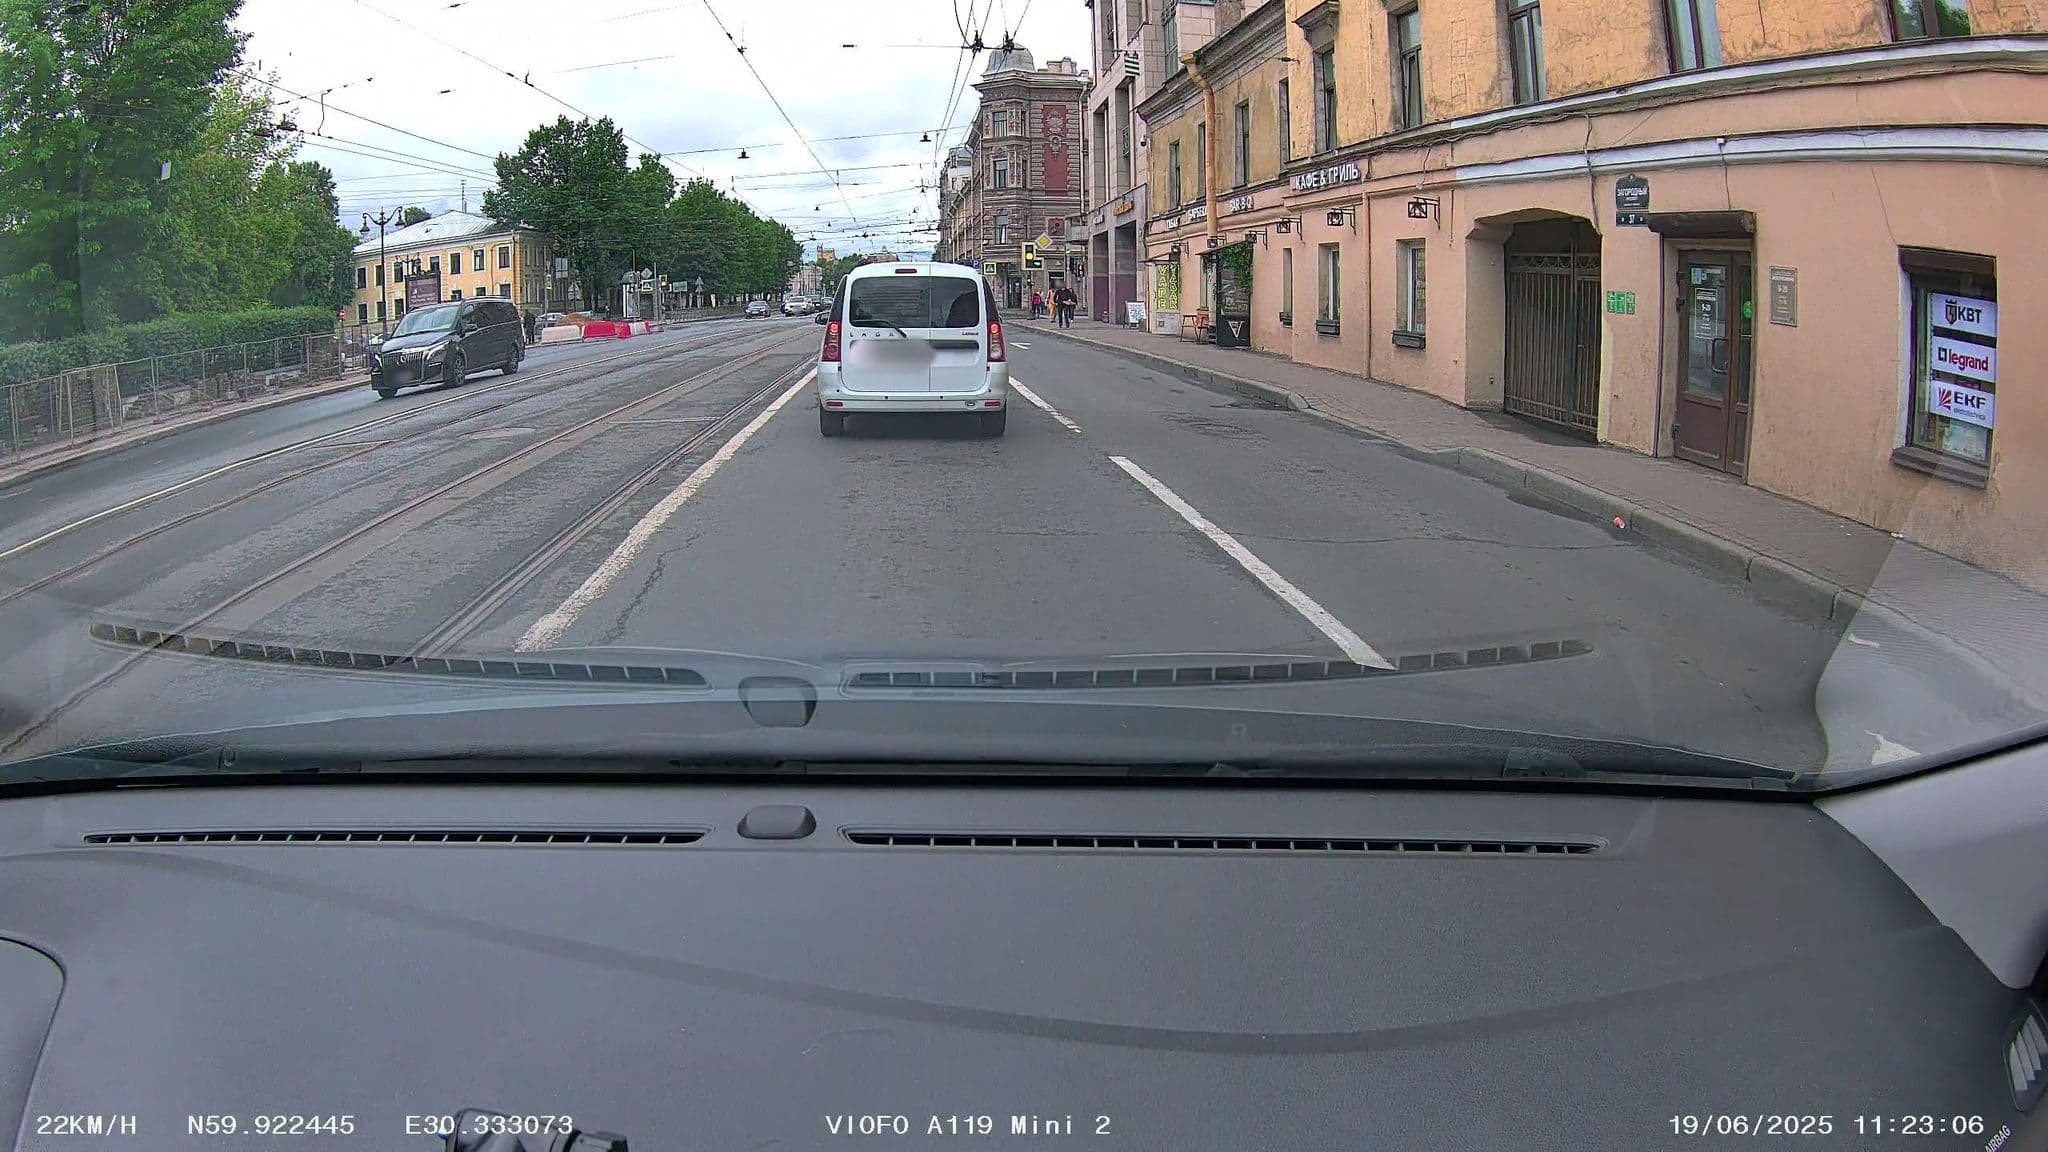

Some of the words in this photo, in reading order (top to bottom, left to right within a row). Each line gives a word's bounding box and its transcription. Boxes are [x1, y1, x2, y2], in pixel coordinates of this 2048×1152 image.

[1295, 171, 1318, 190] КАФЕ
[1319, 170, 1327, 186] &
[1328, 162, 1359, 184] ГРИЛЬ
[1958, 306, 1982, 324] KBT
[1949, 348, 1989, 371] legrand
[1954, 391, 1987, 409] EKF
[1984, 1124, 2011, 1152] AIRBAG
